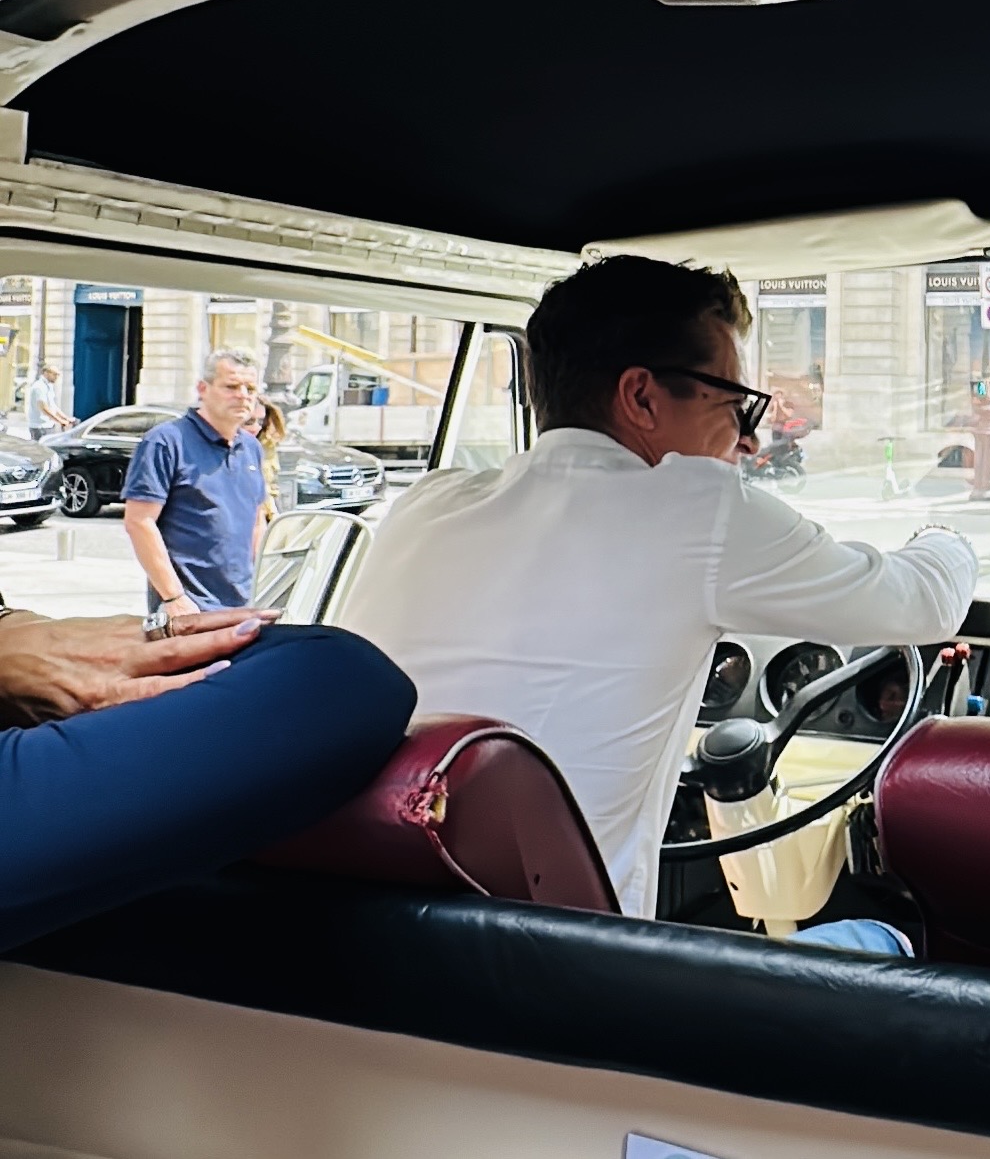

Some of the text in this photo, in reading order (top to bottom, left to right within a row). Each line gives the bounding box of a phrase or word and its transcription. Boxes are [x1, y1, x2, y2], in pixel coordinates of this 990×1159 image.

[760, 280, 827, 290] LOUIS VUITTON
[928, 275, 957, 287] LOUIS
